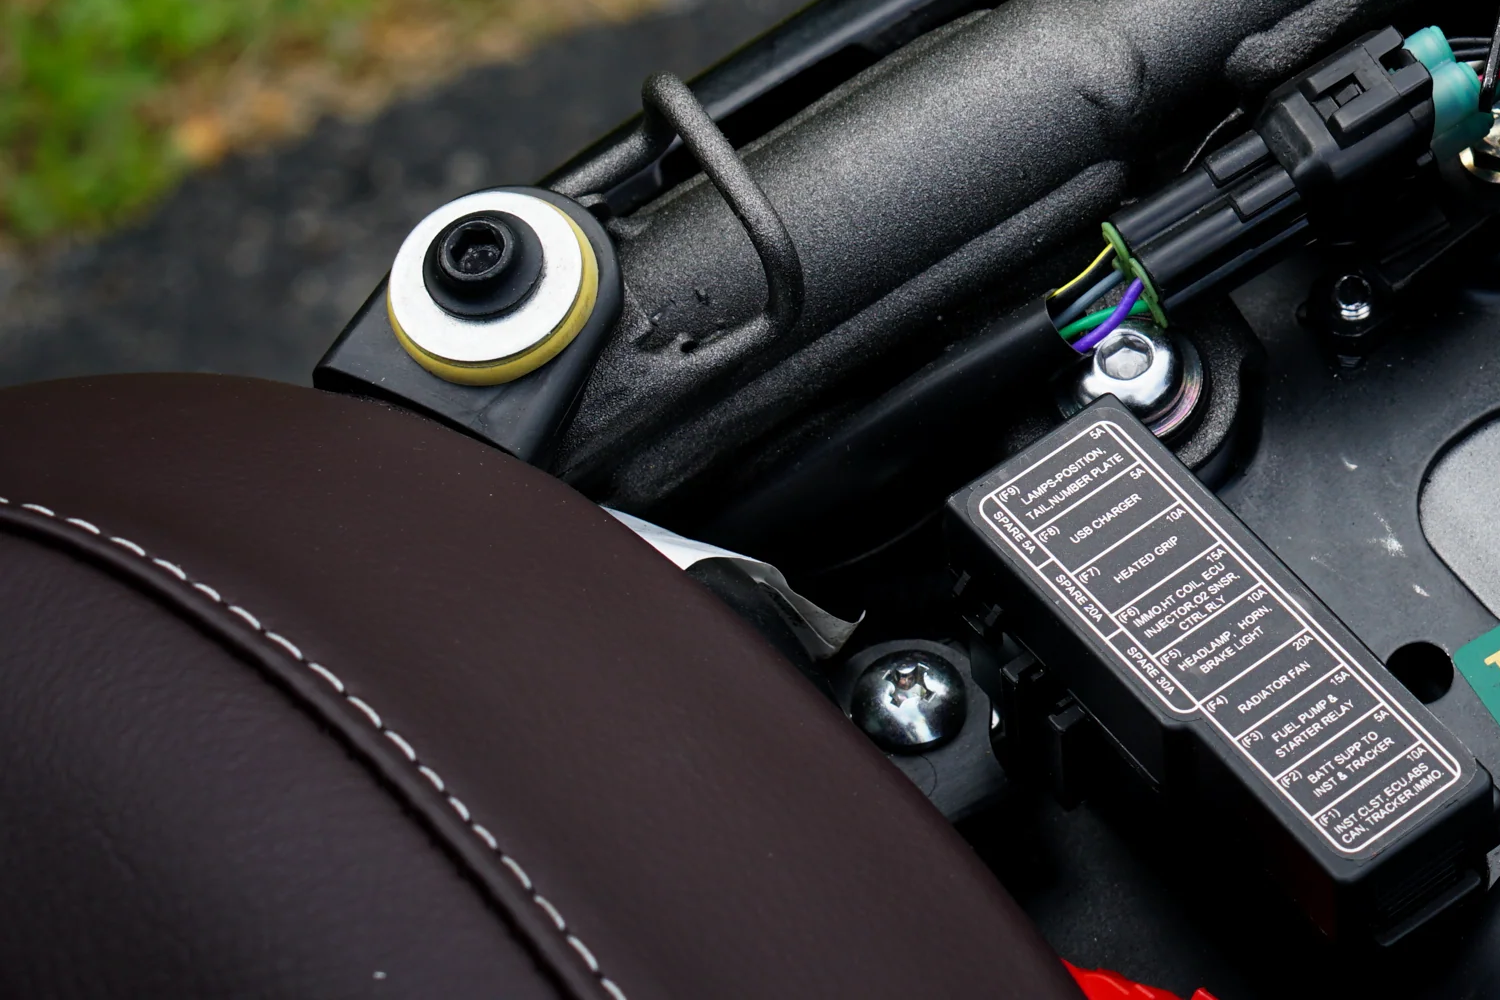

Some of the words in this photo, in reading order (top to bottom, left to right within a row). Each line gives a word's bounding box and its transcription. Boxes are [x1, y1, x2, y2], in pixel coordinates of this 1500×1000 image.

[998, 484, 1021, 503] (F9)
[1089, 427, 1106, 440] 5A
[1020, 447, 1107, 506] LAMPS-POSITION,
[1089, 452, 1125, 478] PLATE
[993, 510, 1026, 543] SPARE
[1021, 539, 1036, 555] 5A
[1038, 525, 1061, 543] (F8)
[1129, 467, 1146, 480] 5A
[1069, 525, 1094, 544] USB
[1091, 493, 1143, 529] CHARGER
[1078, 566, 1101, 584] (F7)
[1165, 507, 1187, 523] 10A
[1113, 552, 1156, 584] HEATED
[1153, 535, 1178, 556] GRIP
[1055, 574, 1089, 606] SPARE
[1083, 603, 1103, 623] 20A
[1118, 605, 1141, 624] (F6)
[1206, 548, 1227, 563] 15A
[1175, 580, 1205, 599] COIL,
[1200, 561, 1226, 581] ECU
[1207, 572, 1241, 595] SNSR,
[1159, 648, 1182, 666] (F5)
[1247, 588, 1268, 604] 10A
[1177, 630, 1237, 672] HEADLAMP,
[1237, 605, 1273, 630] HORN,
[1178, 610, 1208, 631] CTRL
[1204, 594, 1226, 613] RLY
[1126, 646, 1160, 679] SPARE
[1156, 676, 1175, 696] 30A
[1199, 646, 1237, 674] BRAKE
[1233, 625, 1264, 651] LIGHT
[1206, 694, 1229, 713] (F4)
[1292, 634, 1314, 651] 20A
[1237, 674, 1291, 714] RADIATOR
[1287, 660, 1311, 679] FAN
[1241, 730, 1264, 749] (F3)
[1329, 670, 1351, 686] 15A
[1271, 721, 1301, 743] FUEL
[1297, 699, 1327, 724] PUMP
[1327, 694, 1339, 704] &
[1275, 722, 1324, 758] STARTER
[1320, 699, 1354, 727] RELAY
[1280, 769, 1303, 789] (F2)
[1373, 709, 1390, 723] 5A
[1307, 760, 1335, 784] BATT
[1333, 741, 1362, 765] SUPP
[1360, 731, 1379, 745] TO
[1312, 776, 1338, 798] INST
[1336, 771, 1348, 781] &
[1345, 736, 1395, 773] TRACKER
[1318, 808, 1341, 827] (F1)
[1406, 746, 1427, 762] 10A
